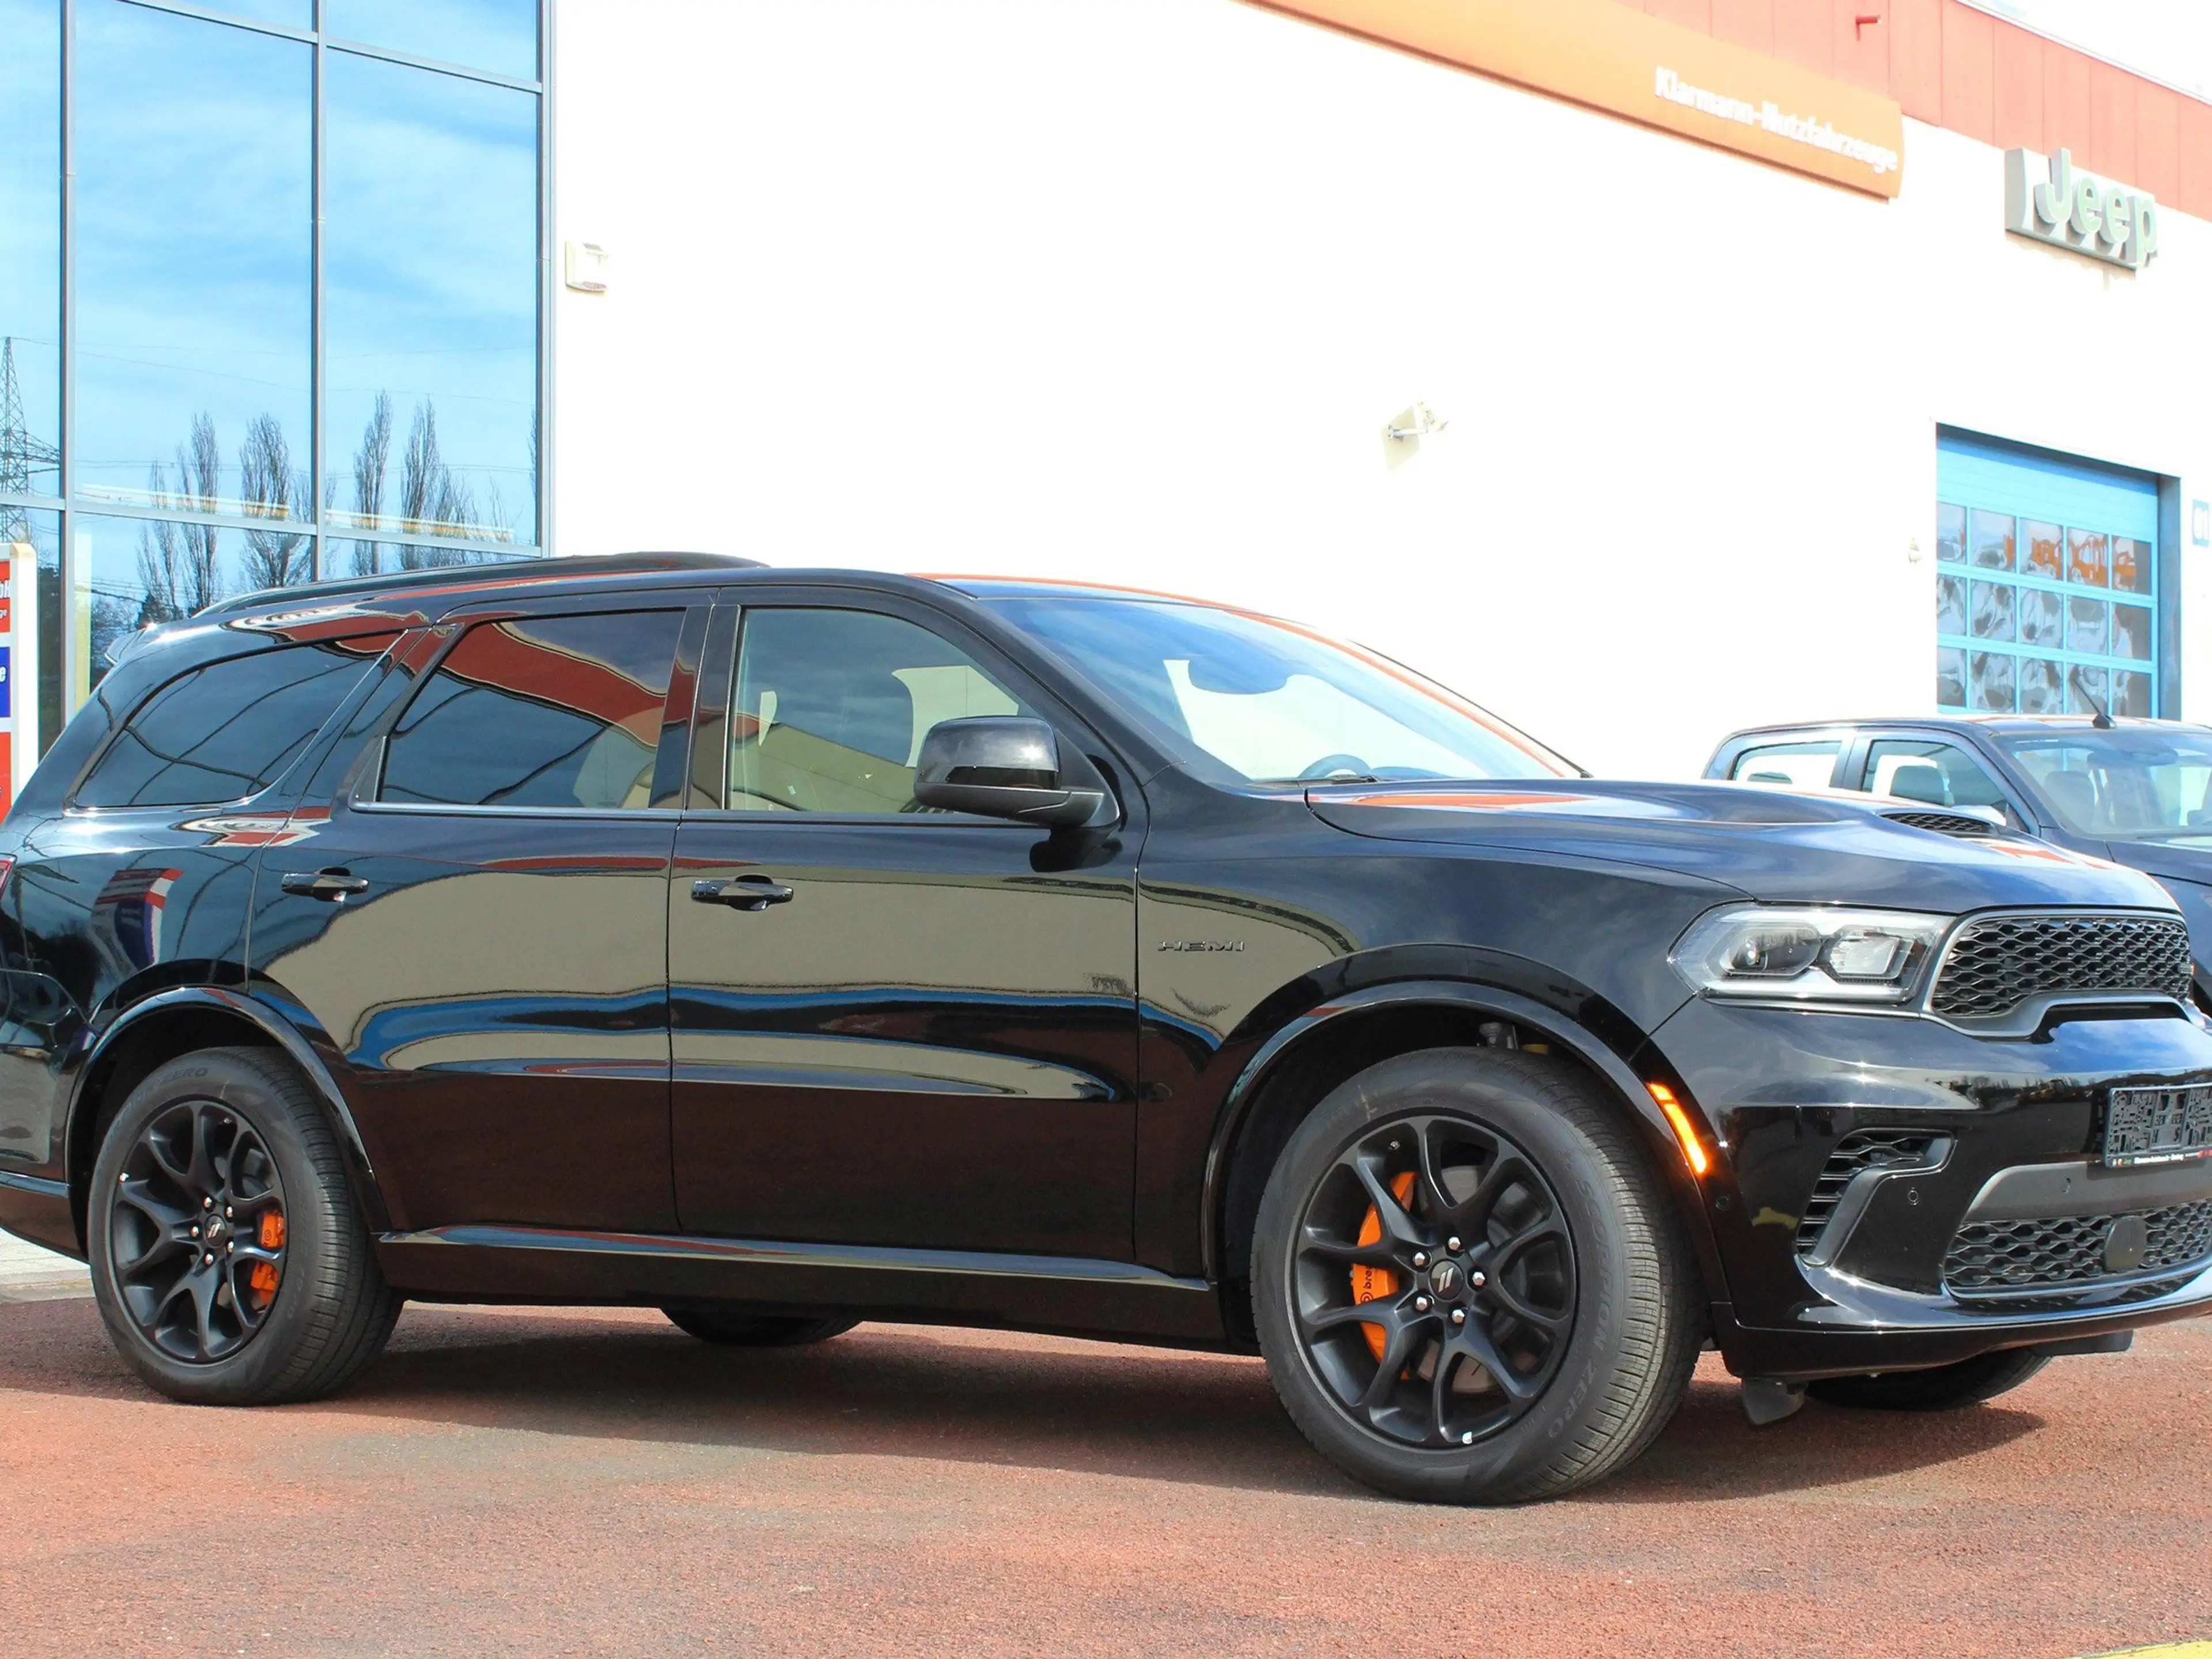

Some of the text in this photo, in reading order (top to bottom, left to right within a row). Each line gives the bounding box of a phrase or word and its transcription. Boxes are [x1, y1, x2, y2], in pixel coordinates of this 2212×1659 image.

[1655, 65, 1897, 173] Klarmann-Nutzfahrzeuge
[2034, 147, 2157, 264] Jeep
[1158, 941, 1244, 951] HEMI
[1363, 1268, 1372, 1289] bre
[1548, 1178, 1613, 1438] SCORPION ZERO
